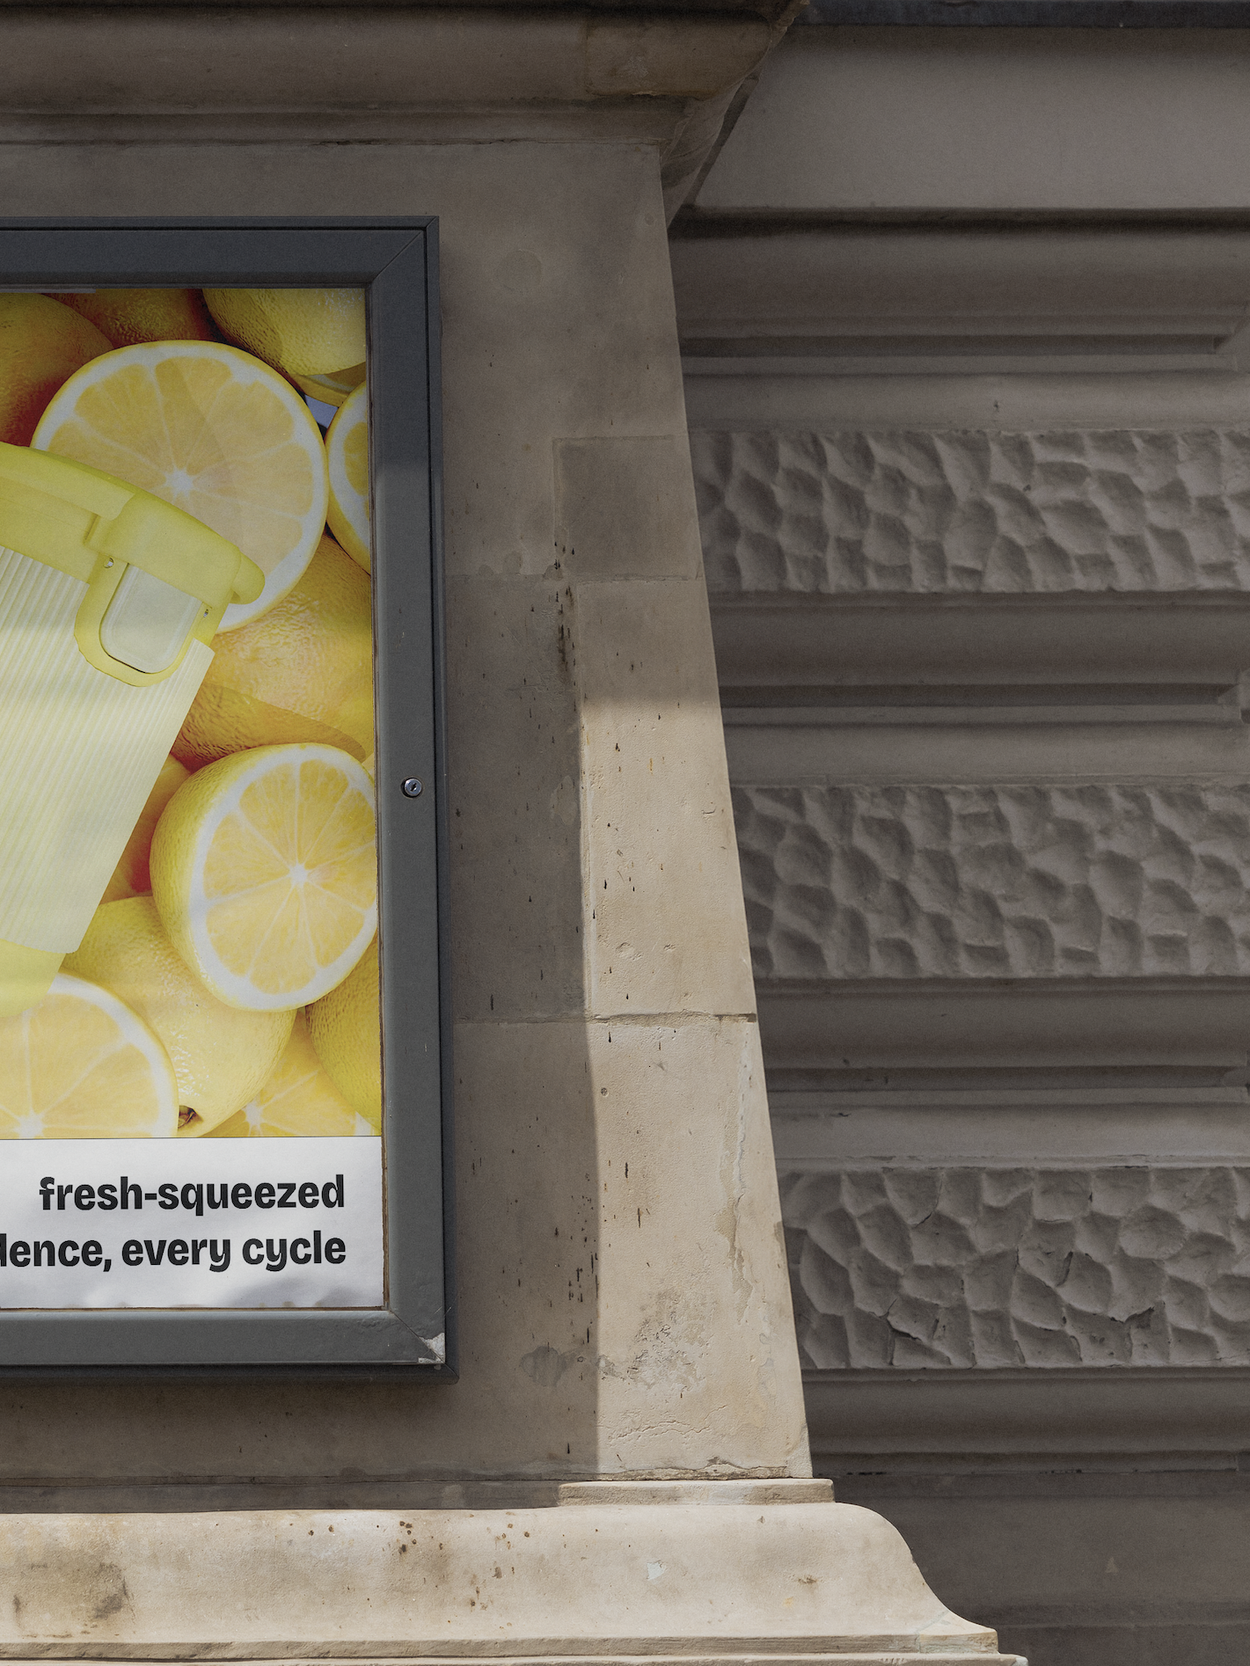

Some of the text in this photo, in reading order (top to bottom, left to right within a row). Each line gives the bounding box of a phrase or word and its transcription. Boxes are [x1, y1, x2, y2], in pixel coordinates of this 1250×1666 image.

[39, 1174, 345, 1216] fresh-squeezed
[121, 1237, 231, 1273] every
[241, 1230, 347, 1272] cycle
